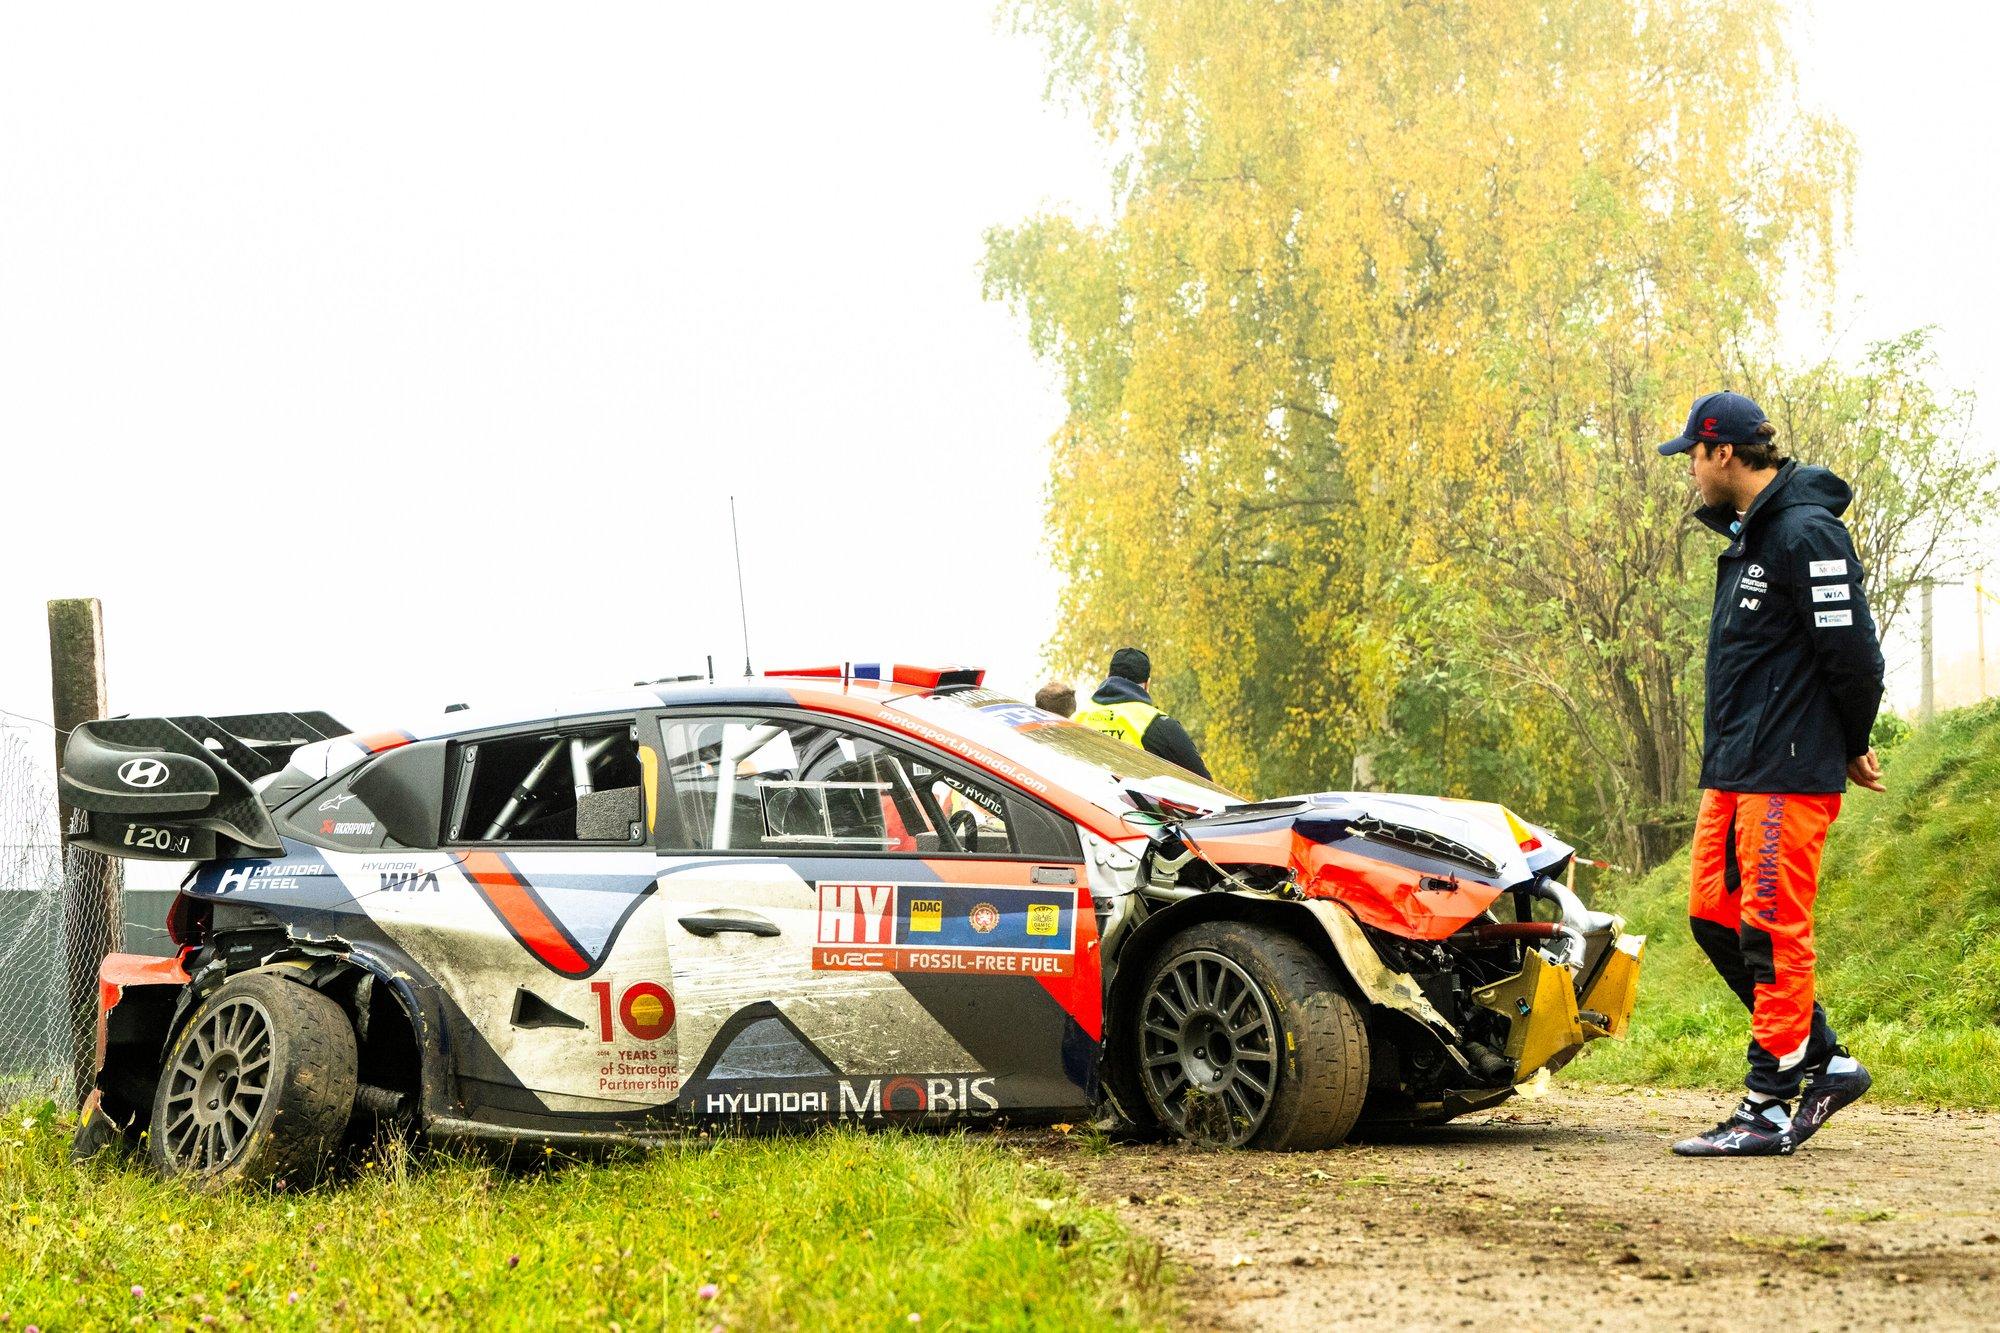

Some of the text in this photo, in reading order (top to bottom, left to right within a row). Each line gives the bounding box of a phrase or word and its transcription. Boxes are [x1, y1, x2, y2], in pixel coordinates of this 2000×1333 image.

[877, 710, 1048, 793] motorsport.hyundai.com
[965, 786, 1004, 816] HYUND
[253, 864, 324, 877] HYUNDAI
[361, 861, 416, 871] HYUNDAI
[249, 877, 299, 890] STEEL
[379, 868, 440, 893] WIA
[819, 885, 891, 943] HY
[912, 901, 941, 913] ADAC
[823, 952, 1063, 973] WRC FOSSIL-FREE FUEL
[618, 1050, 657, 1060] YEARS
[600, 1061, 677, 1077] of Strategic
[600, 1077, 678, 1091] Partnership
[706, 1076, 999, 1119] HYUNDAI MOBIS
